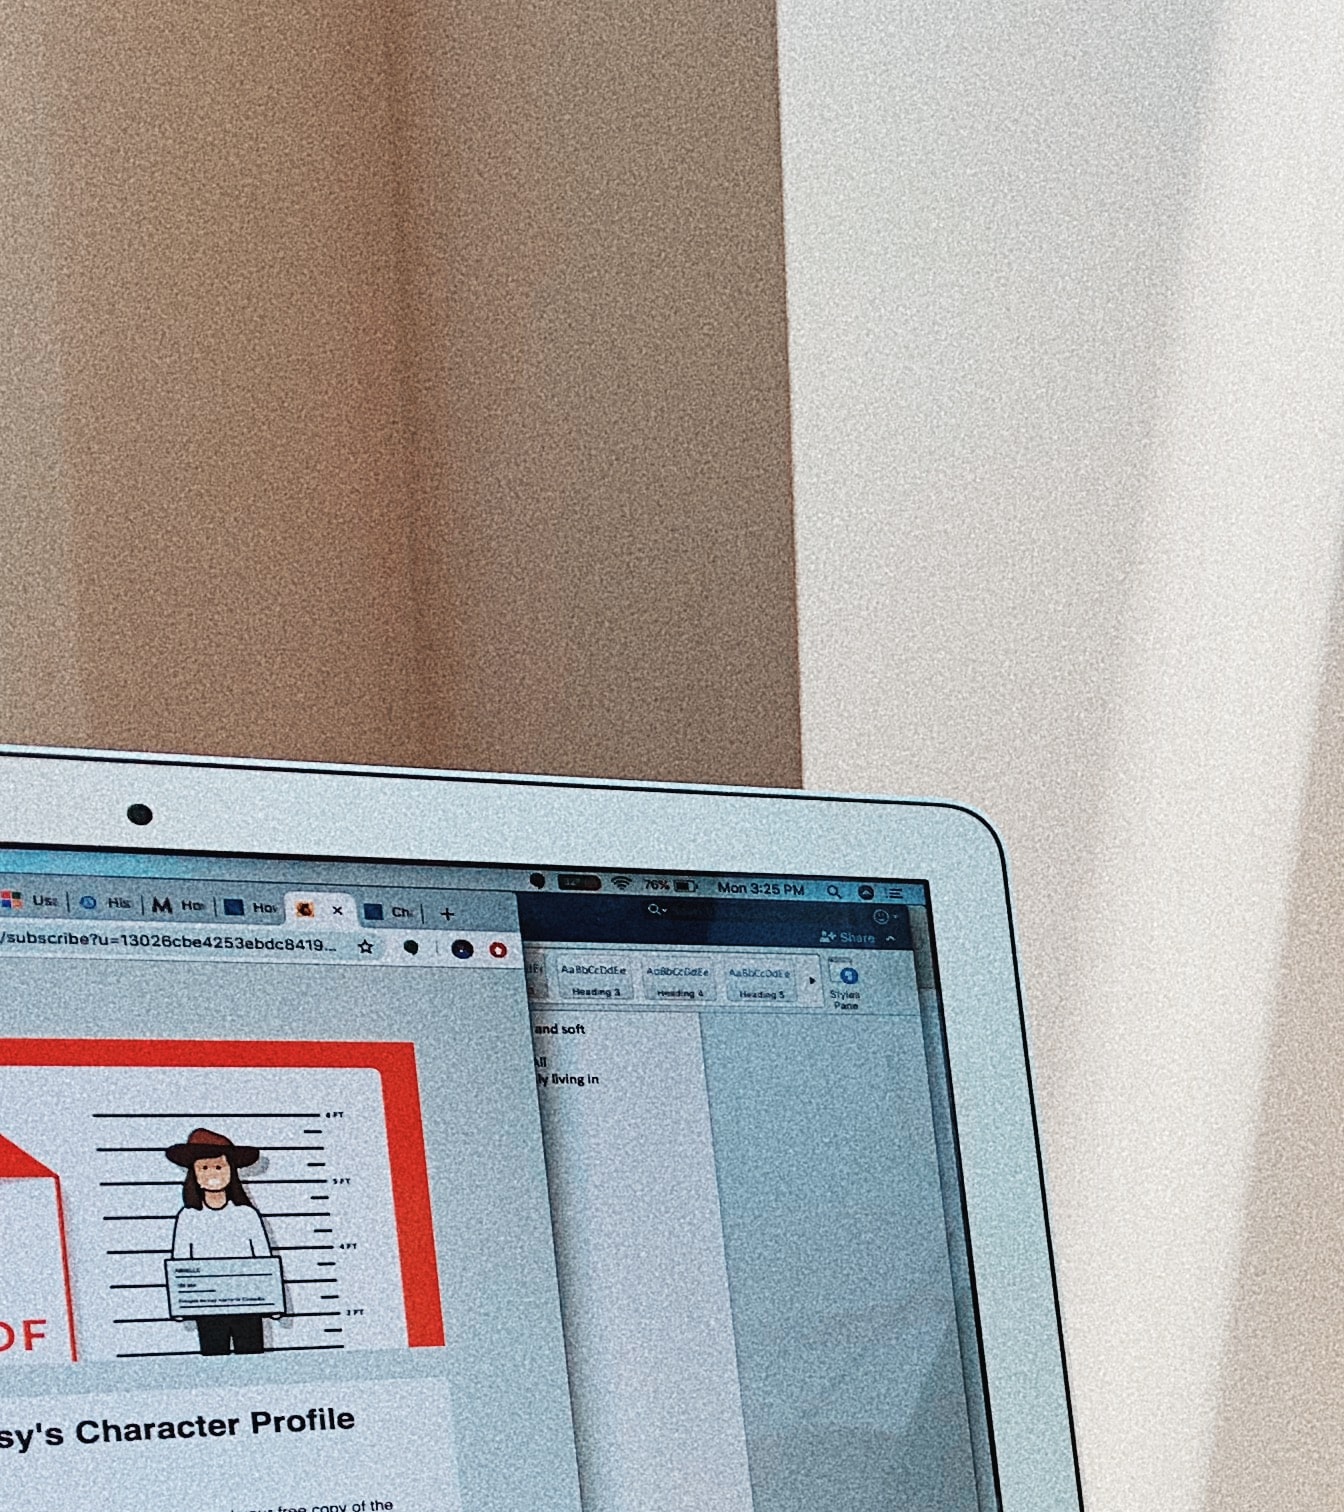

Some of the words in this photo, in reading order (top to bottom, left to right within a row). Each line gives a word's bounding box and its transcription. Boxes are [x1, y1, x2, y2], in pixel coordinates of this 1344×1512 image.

[644, 879, 670, 891] 76%
[718, 881, 748, 894] Mon
[750, 883, 781, 895] 3:25
[784, 884, 805, 896] PM
[840, 932, 876, 944] Share
[573, 988, 612, 998] Heading
[657, 990, 695, 1000] Heading
[740, 990, 777, 1000] Heading
[830, 990, 861, 1001] Styles
[834, 1001, 859, 1010] Pane
[535, 1023, 559, 1035] and
[562, 1023, 586, 1035] soft
[552, 1073, 585, 1087] living
[588, 1073, 600, 1085] in
[0, 1422, 64, 1454] sy's
[76, 1415, 240, 1444] Character
[251, 1407, 355, 1434] Profile
[352, 1500, 366, 1512] of
[370, 1499, 394, 1512] the
